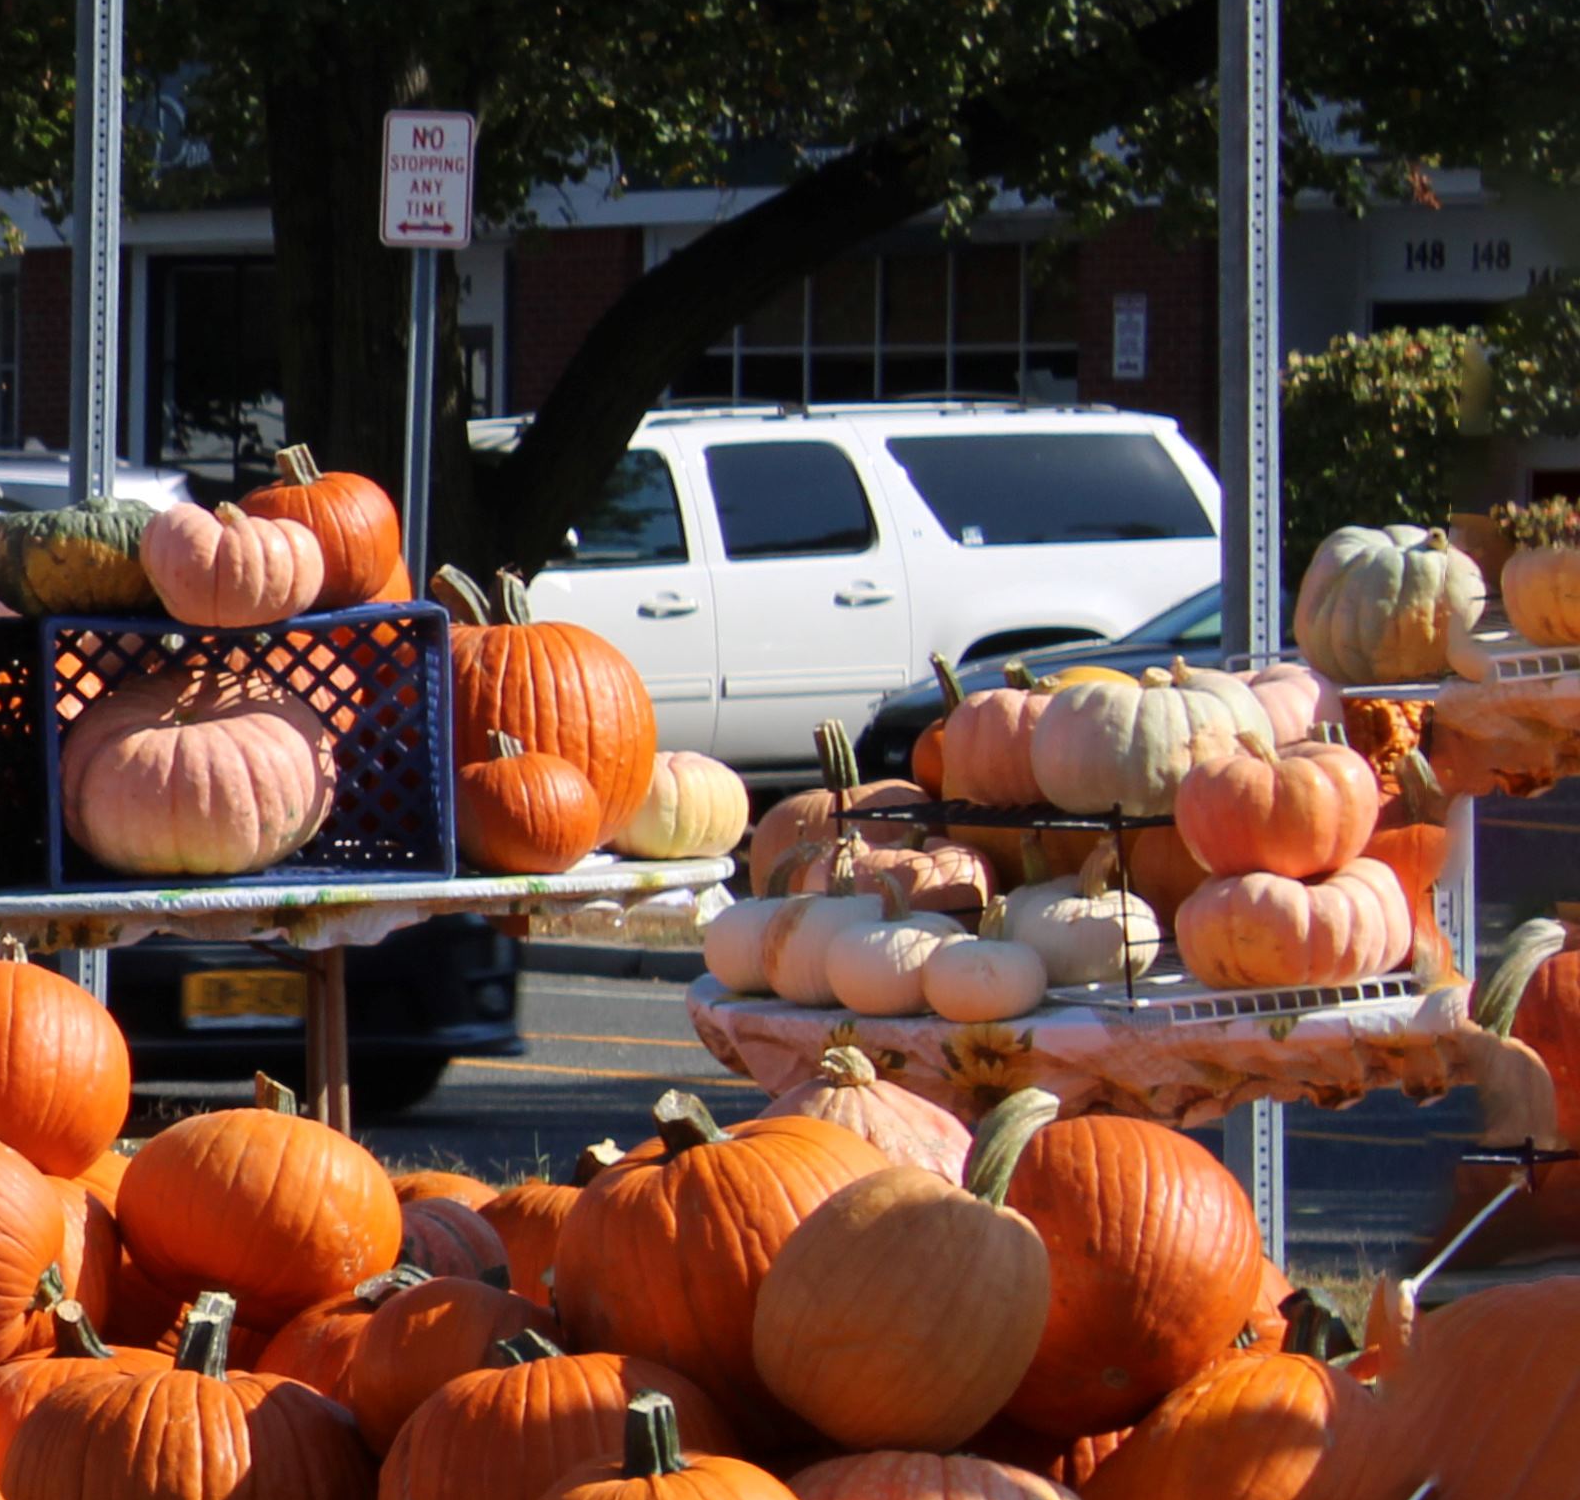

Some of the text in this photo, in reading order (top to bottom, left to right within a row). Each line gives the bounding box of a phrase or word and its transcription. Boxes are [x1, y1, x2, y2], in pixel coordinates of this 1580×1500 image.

[412, 126, 444, 150] NO
[390, 155, 465, 174] STOPPING
[410, 179, 443, 195] ANY
[407, 201, 445, 217] TIME
[1405, 239, 1510, 270] 148 148
